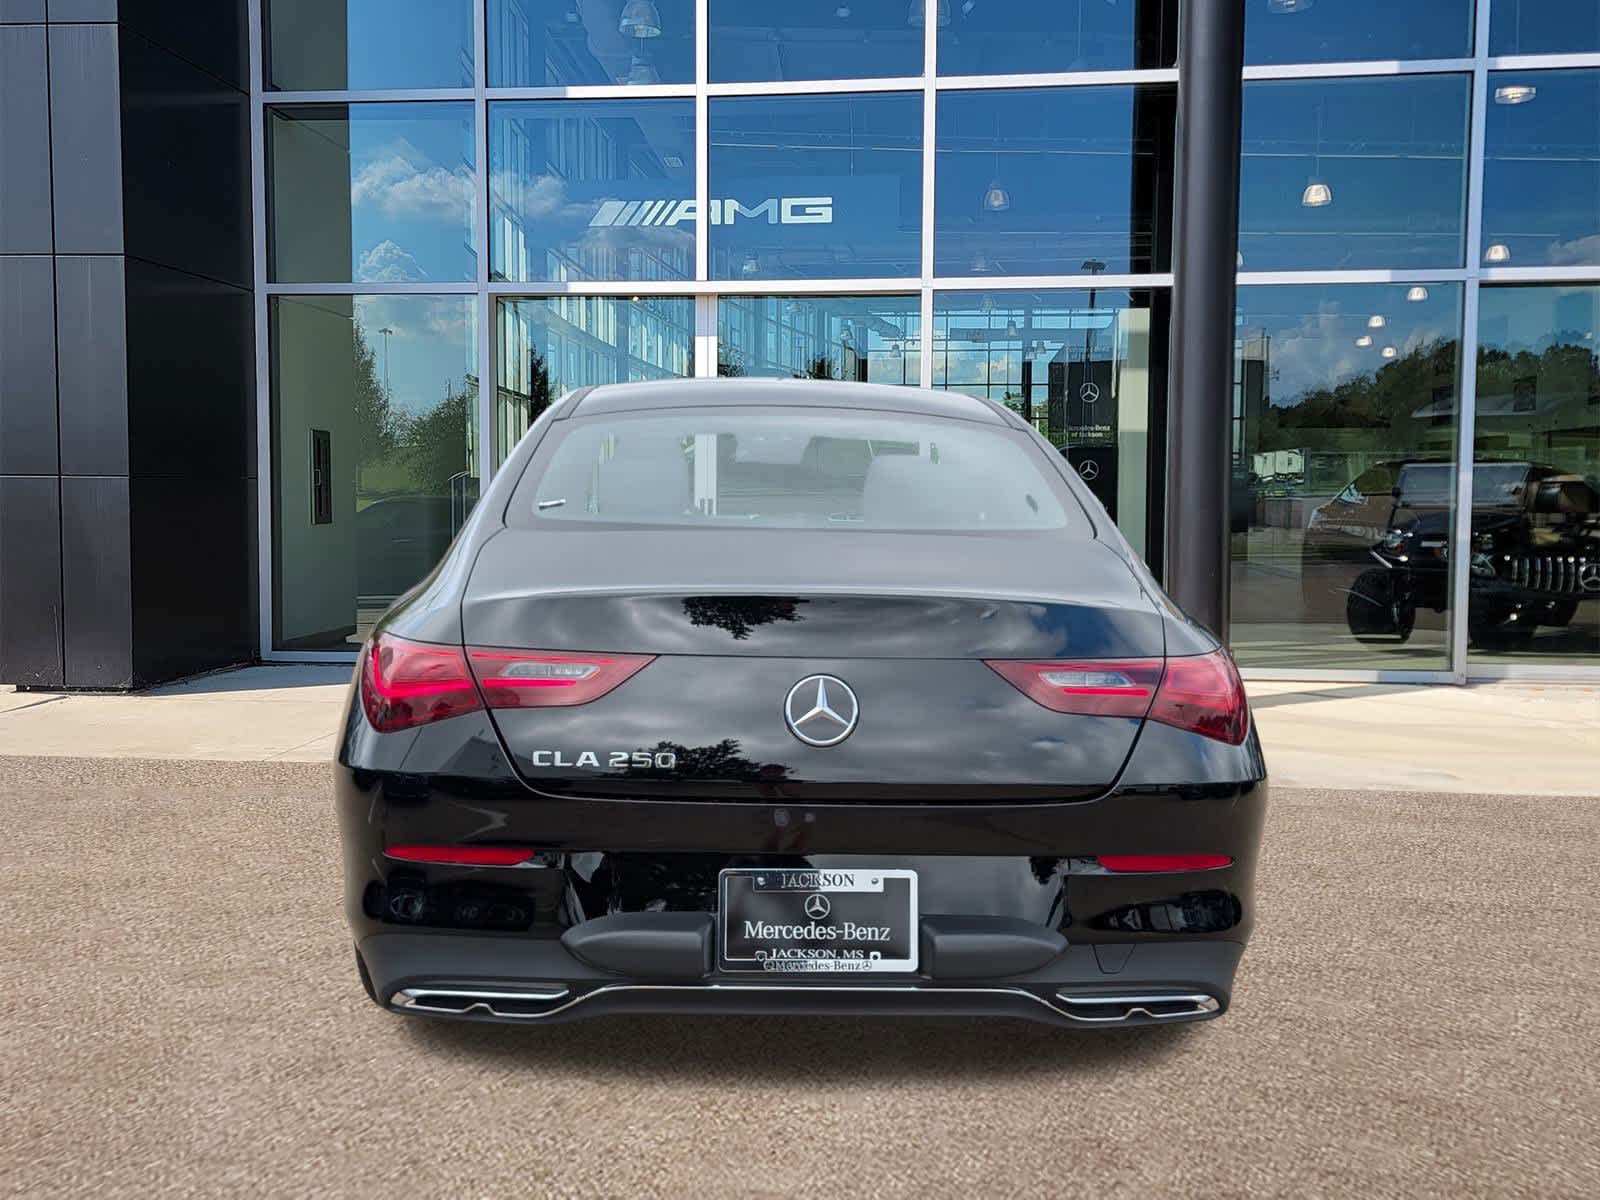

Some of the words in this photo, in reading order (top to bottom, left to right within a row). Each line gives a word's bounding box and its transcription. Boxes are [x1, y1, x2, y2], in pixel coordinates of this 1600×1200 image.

[665, 197, 833, 227] AMG
[532, 750, 600, 767] CLA
[608, 751, 676, 768] 250
[781, 873, 855, 888] JACKSON
[743, 920, 891, 942] Mercedes-Benz
[843, 949, 865, 959] MS
[776, 960, 861, 972] Mercedes-Benz
